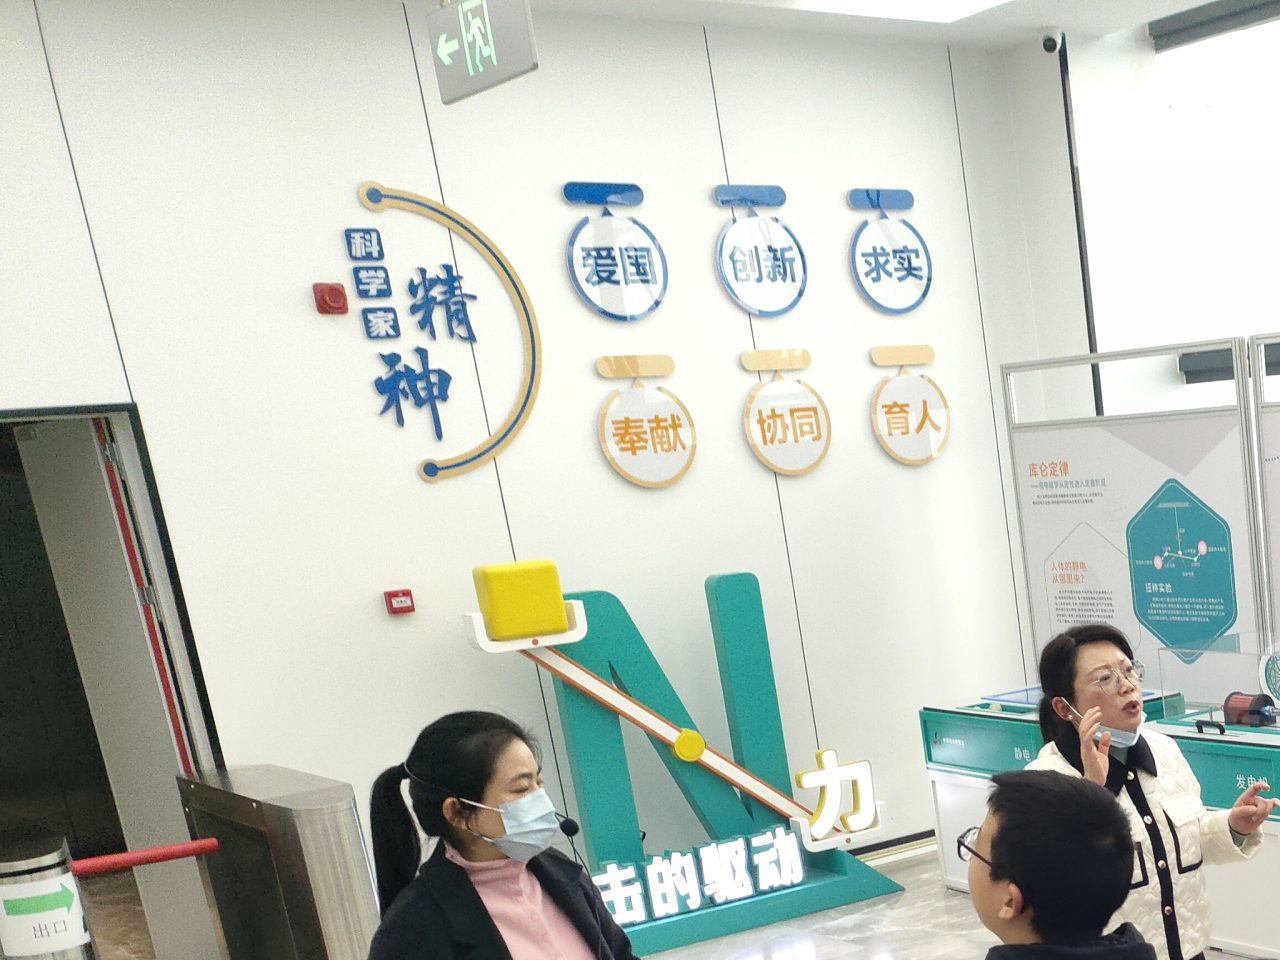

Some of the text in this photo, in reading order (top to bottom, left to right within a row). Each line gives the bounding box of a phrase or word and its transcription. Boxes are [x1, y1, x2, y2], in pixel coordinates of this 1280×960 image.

[349, 230, 399, 338] 科学家
[581, 245, 658, 287] 爱国
[728, 244, 798, 285] 创新
[862, 244, 924, 283] 求实
[374, 263, 478, 441] 精神
[611, 412, 684, 457] 奉献
[756, 405, 822, 447] 协同
[881, 400, 943, 437] 育人
[1028, 459, 1070, 478] 库仑定律
[797, 747, 877, 840] 力
[32, 919, 68, 939] 出口
